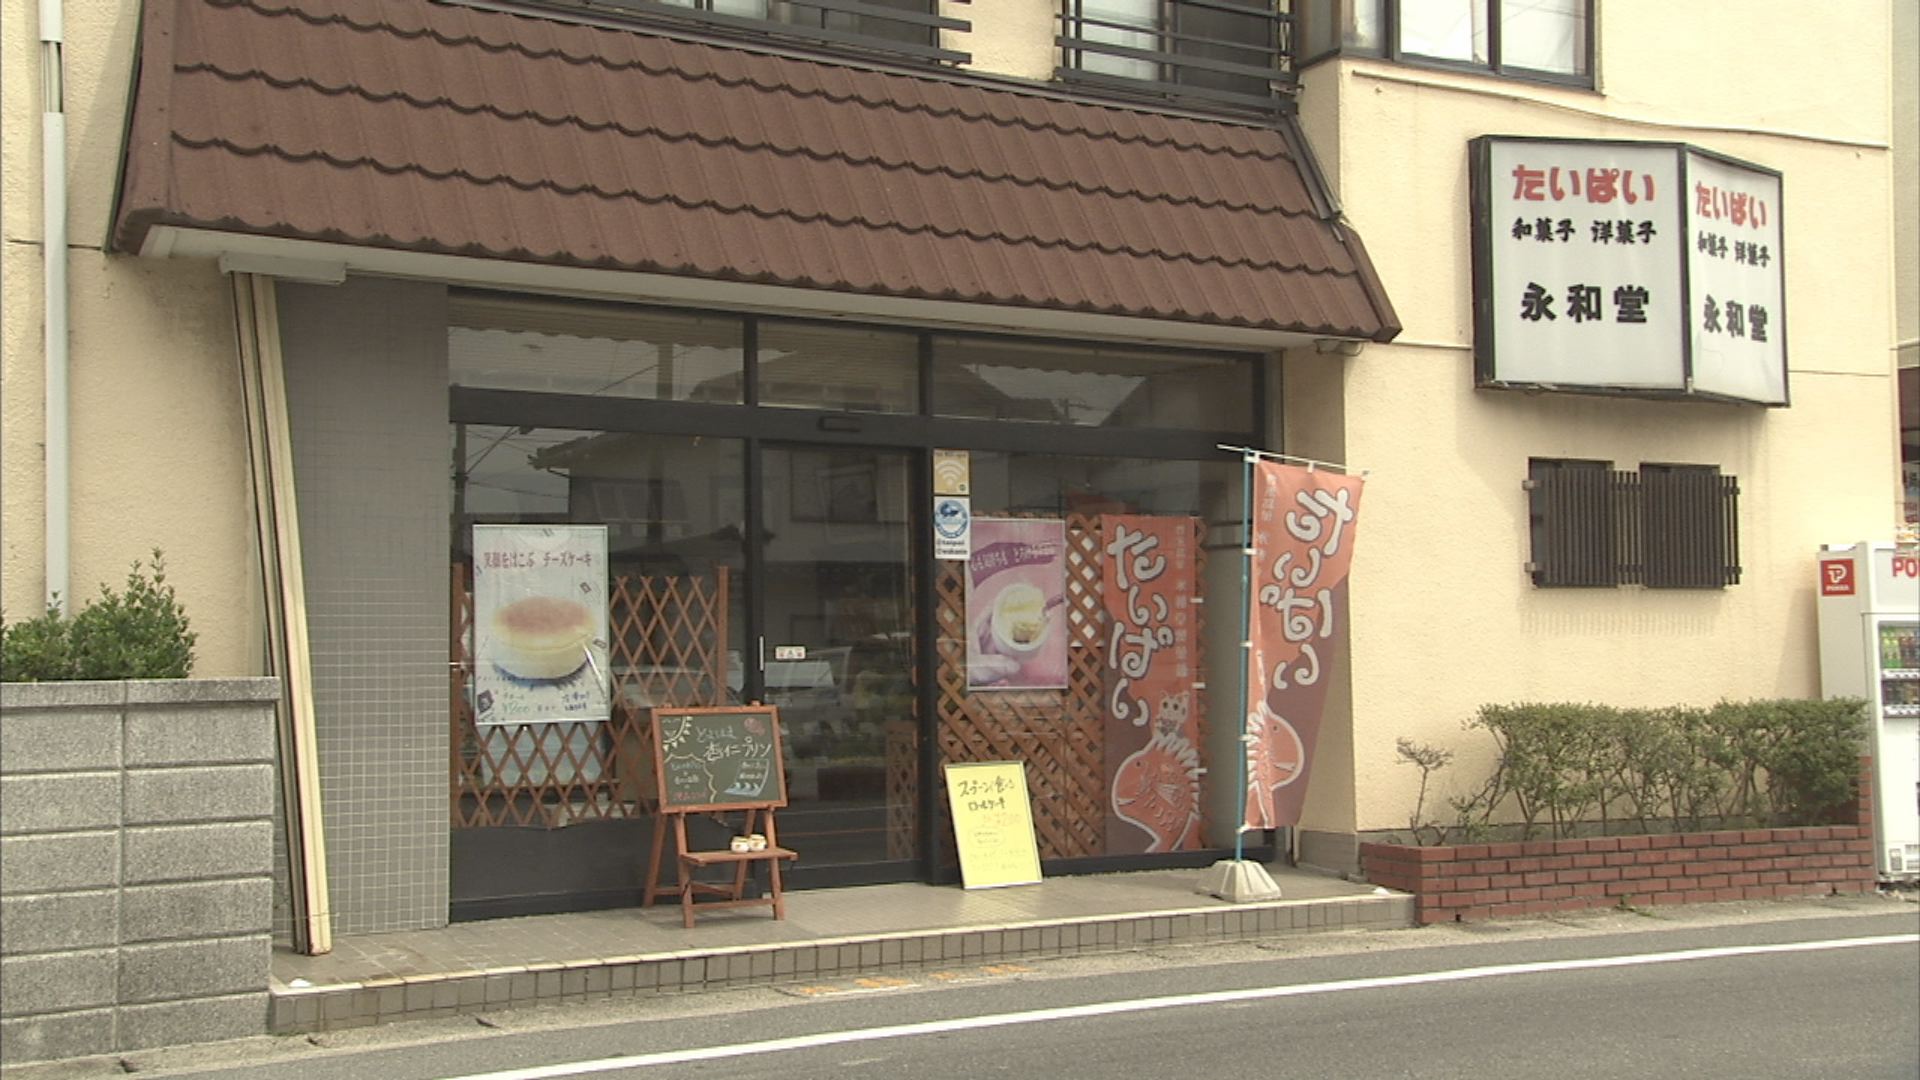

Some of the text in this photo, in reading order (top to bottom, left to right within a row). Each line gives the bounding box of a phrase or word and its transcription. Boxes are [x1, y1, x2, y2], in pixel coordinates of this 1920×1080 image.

[1512, 164, 1655, 205] たいぱい
[1695, 180, 1767, 229] たいぱい
[1512, 217, 1657, 245] 和菓子 洋菓子
[1697, 230, 1770, 268] 和菓子 洋菓子
[1521, 282, 1650, 324] 永和堂
[1703, 294, 1768, 343] 永和堂
[543, 550, 593, 568] チーズケーキ
[1891, 557, 1920, 579] PO
[1107, 523, 1174, 728] たいぱい
